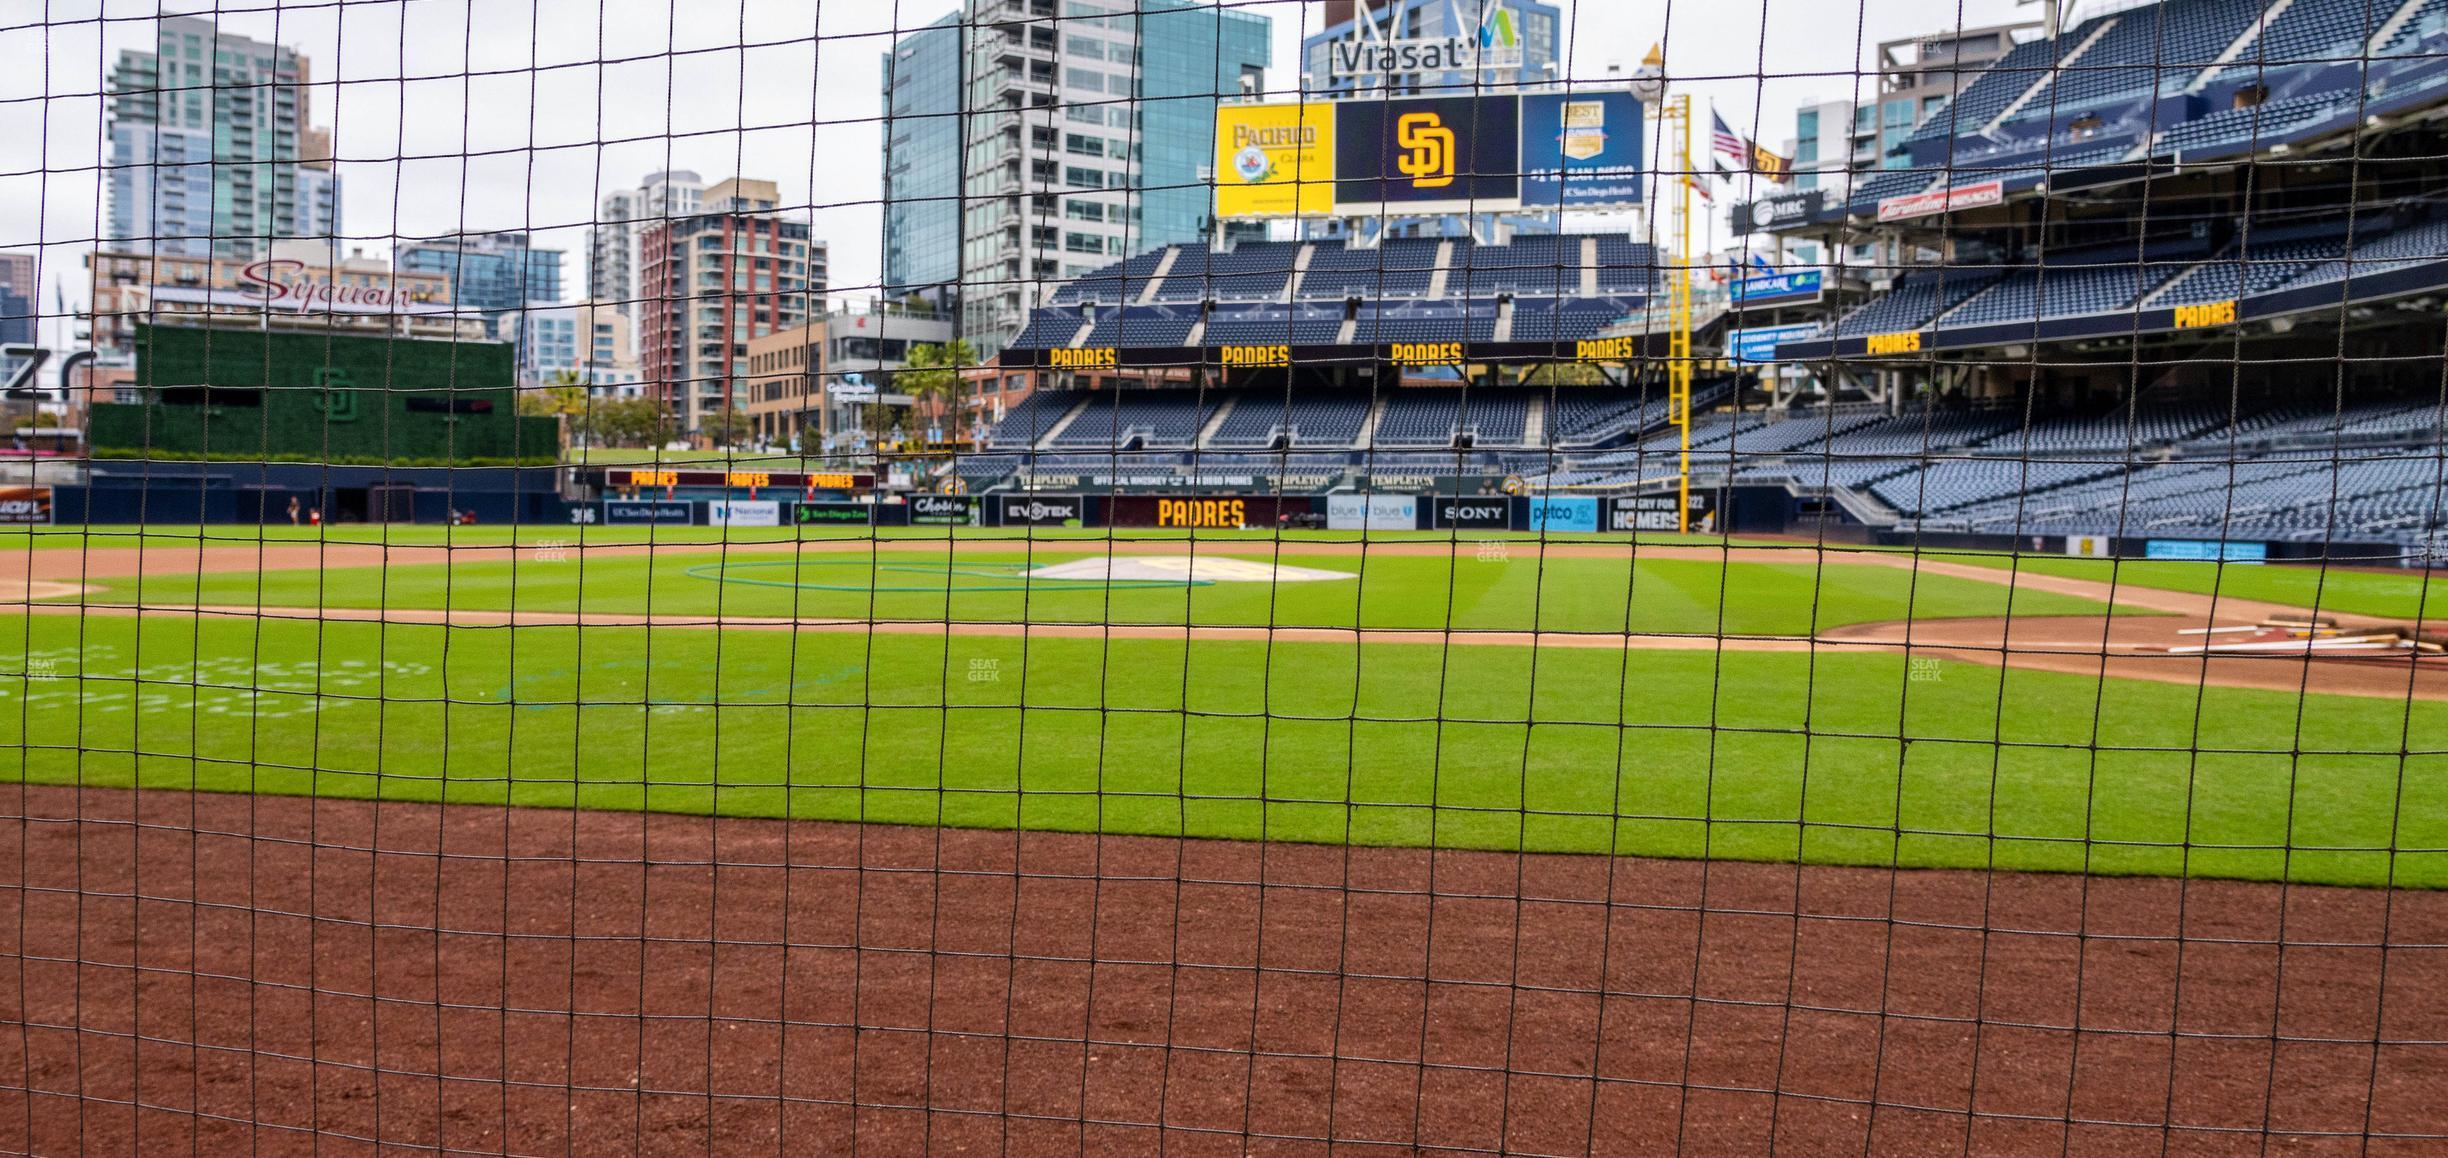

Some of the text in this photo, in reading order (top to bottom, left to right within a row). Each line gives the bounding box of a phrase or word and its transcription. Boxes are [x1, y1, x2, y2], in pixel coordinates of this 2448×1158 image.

[1340, 38, 1462, 72] Viasat
[1232, 123, 1317, 149] PACIFICO
[1398, 112, 1455, 188] SD
[1567, 167, 1594, 181] SAN
[1596, 165, 1634, 180] DIEGO
[1773, 199, 1806, 217] MRC
[241, 259, 413, 314] Sycuan
[2174, 301, 2236, 329] PADRES
[1577, 337, 1633, 363] PADRES
[1867, 332, 1921, 355] PADRES
[1050, 347, 1116, 369] PADRES
[1221, 345, 1290, 367] PADRES
[1391, 342, 1462, 366] PADRES
[1265, 475, 1329, 486] TEMPLETON
[1370, 475, 1435, 487] TEMPLETON
[735, 506, 775, 516] National
[914, 497, 966, 512] Chosen
[1158, 500, 1245, 527] PADRES
[1331, 506, 1357, 516] blue
[1373, 506, 1400, 516] blue
[1444, 506, 1503, 519] SONY
[1533, 504, 1573, 523] petco
[1617, 498, 1677, 510] HUNGRY FOR
[1612, 511, 1681, 530] HOMERS
